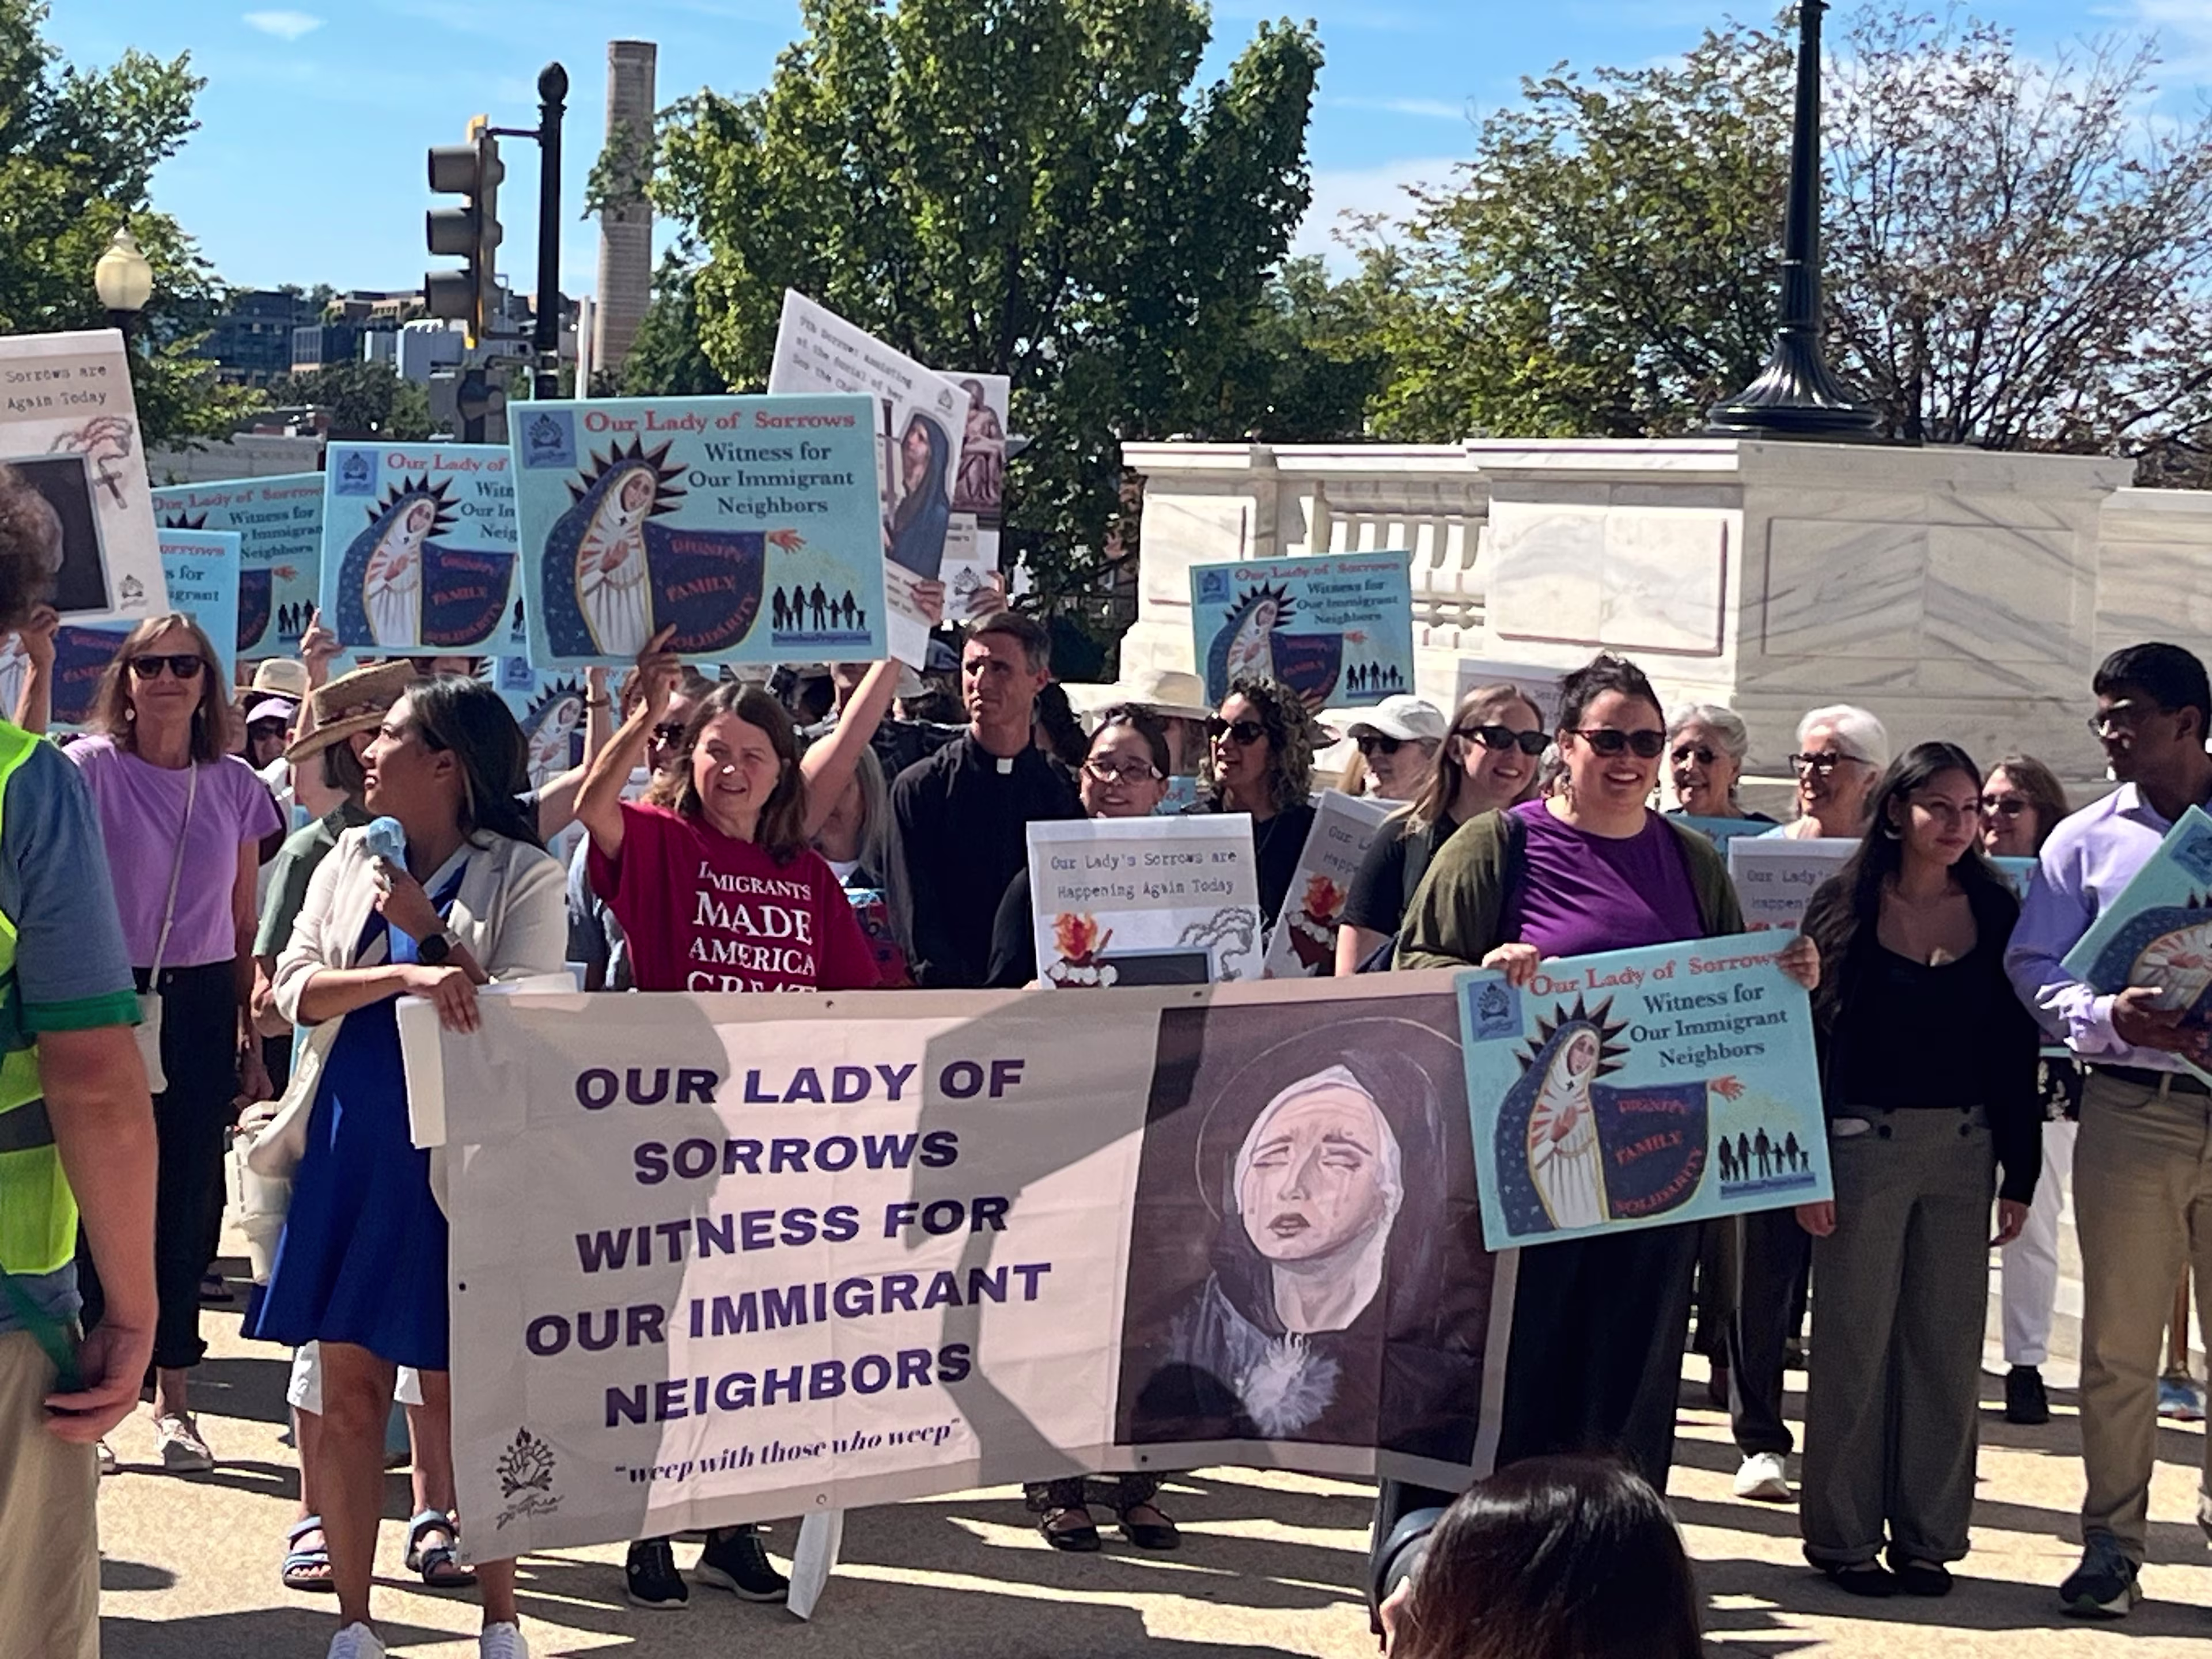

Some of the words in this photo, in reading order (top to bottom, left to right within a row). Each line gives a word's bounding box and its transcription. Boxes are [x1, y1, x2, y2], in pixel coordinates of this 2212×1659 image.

[79, 365, 107, 377] are
[60, 391, 107, 405] Today
[584, 411, 637, 433] Our
[645, 411, 709, 434] Lady
[714, 410, 741, 429] of
[755, 411, 855, 429] Sorrows
[705, 442, 793, 461] Witness
[801, 441, 832, 460] for
[387, 453, 427, 469] Our
[433, 454, 482, 475] Lady
[487, 459, 509, 471] of
[688, 471, 731, 488] Our
[737, 469, 854, 491] Immigrant
[293, 506, 315, 518] for
[462, 503, 494, 518] Our
[718, 497, 828, 518] Neighbors
[180, 565, 204, 582] for
[1365, 579, 1386, 590] for
[666, 575, 735, 601] FAMILY
[1296, 599, 1324, 609] Our
[1329, 826, 1353, 843] Our
[1050, 855, 1077, 870] Our
[1085, 852, 1136, 870] Lady's
[1144, 853, 1203, 865] Sorrows
[1211, 851, 1237, 862] are
[1747, 870, 1774, 883] Our
[1058, 884, 1135, 900] Happening
[1143, 882, 1184, 896] Again
[1192, 879, 1234, 895] Today
[692, 890, 813, 945] MADE
[688, 936, 816, 977] AMERICA
[1530, 975, 1578, 997] Our
[1585, 965, 1645, 991] Lady
[1653, 960, 1676, 979] of
[1643, 991, 1728, 1015] Witness
[1732, 983, 1764, 1003] for
[1629, 1026, 1670, 1042] Our
[1675, 1009, 1788, 1037] Immigrant
[1658, 1041, 1765, 1069] Neighbors
[576, 1067, 719, 1109] OUR
[744, 1063, 917, 1104] LADY
[940, 1059, 1025, 1099] OF
[634, 1131, 959, 1185] SORROWS
[1616, 1130, 1683, 1165] FAMILY
[575, 1205, 860, 1273] WITNESS
[882, 1196, 1010, 1238] FOR
[525, 1304, 665, 1355] OUR
[688, 1263, 1053, 1338] IMMIGRANT
[604, 1343, 972, 1427] NEIGHBORS
[694, 1449, 756, 1476] with
[760, 1441, 827, 1466] those
[832, 1435, 882, 1457] who
